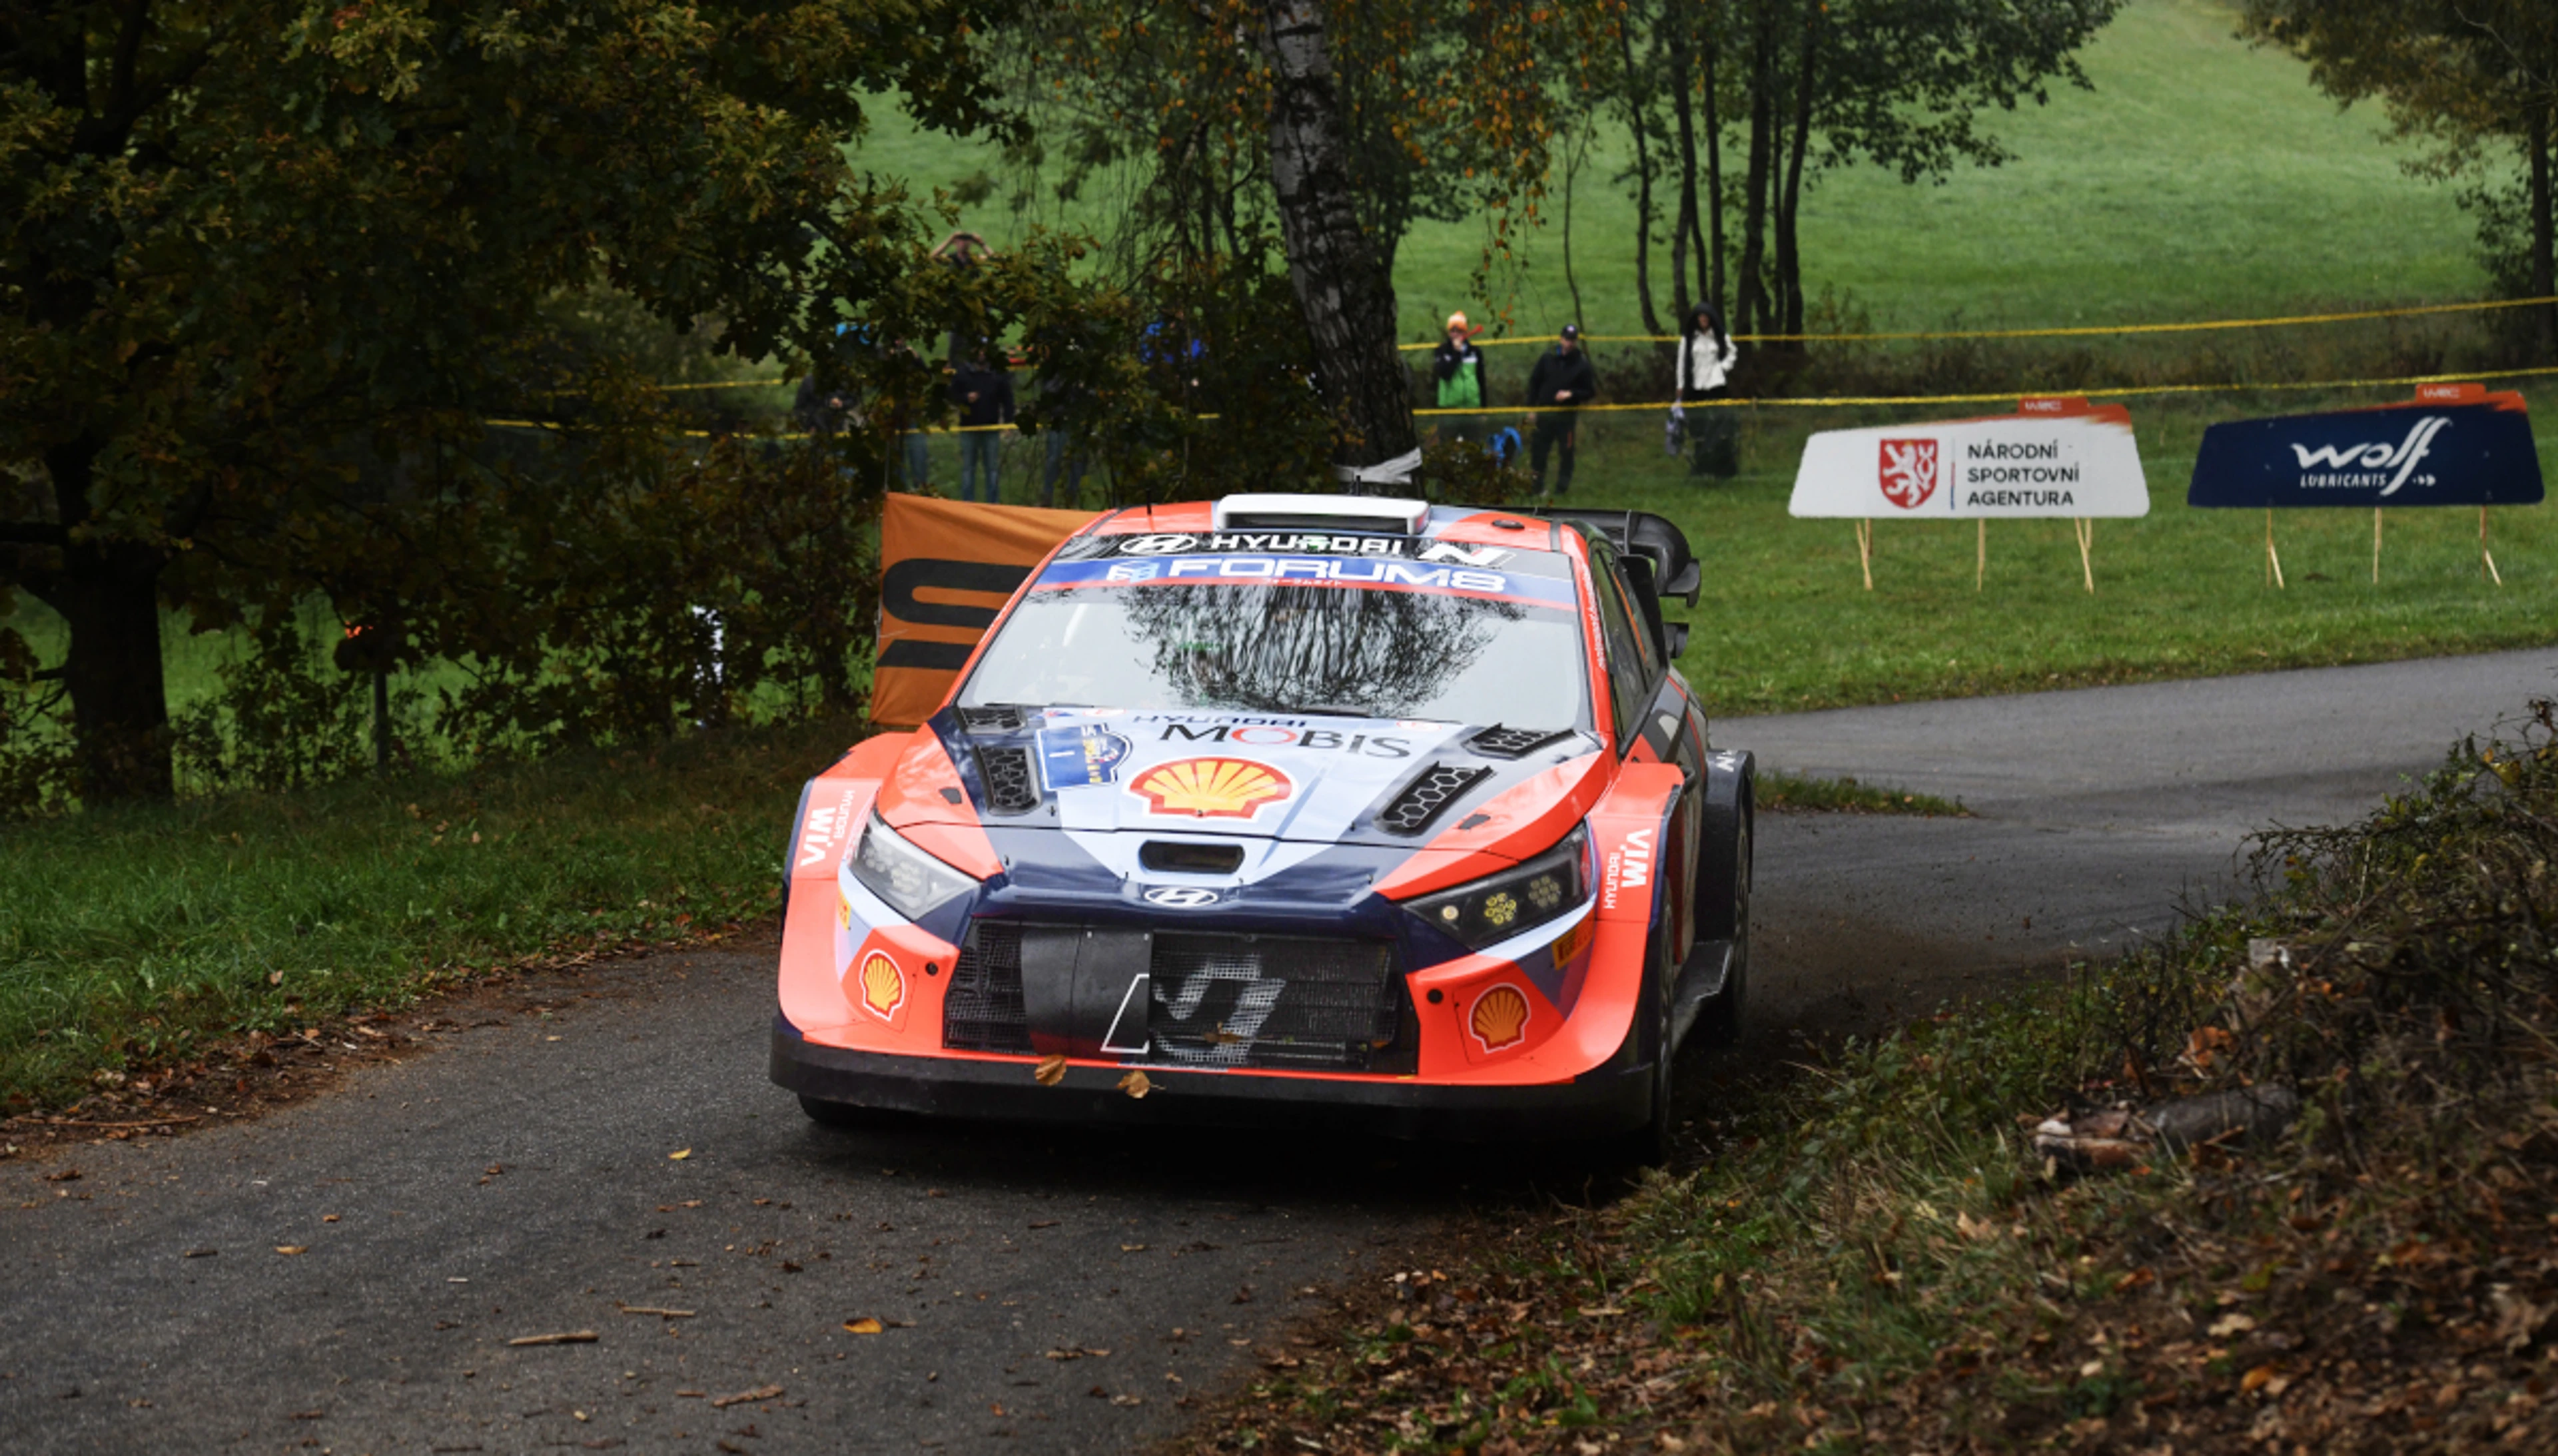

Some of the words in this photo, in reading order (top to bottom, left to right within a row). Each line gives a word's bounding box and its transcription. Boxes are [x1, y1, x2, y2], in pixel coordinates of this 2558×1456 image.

[1967, 439, 2058, 460] NÁRODNÍ
[1967, 461, 2080, 483] SPORTOVNÍ
[2300, 474, 2386, 488] LUBRICANTS
[1967, 490, 2074, 506] AGENTURA
[1210, 534, 1403, 555] HYUNDAI
[1168, 557, 1506, 593] FORUM8
[1133, 715, 1307, 727] HYUNDAI
[1159, 723, 1411, 758] MOBIS
[1603, 852, 1621, 909] HYUNDAI
